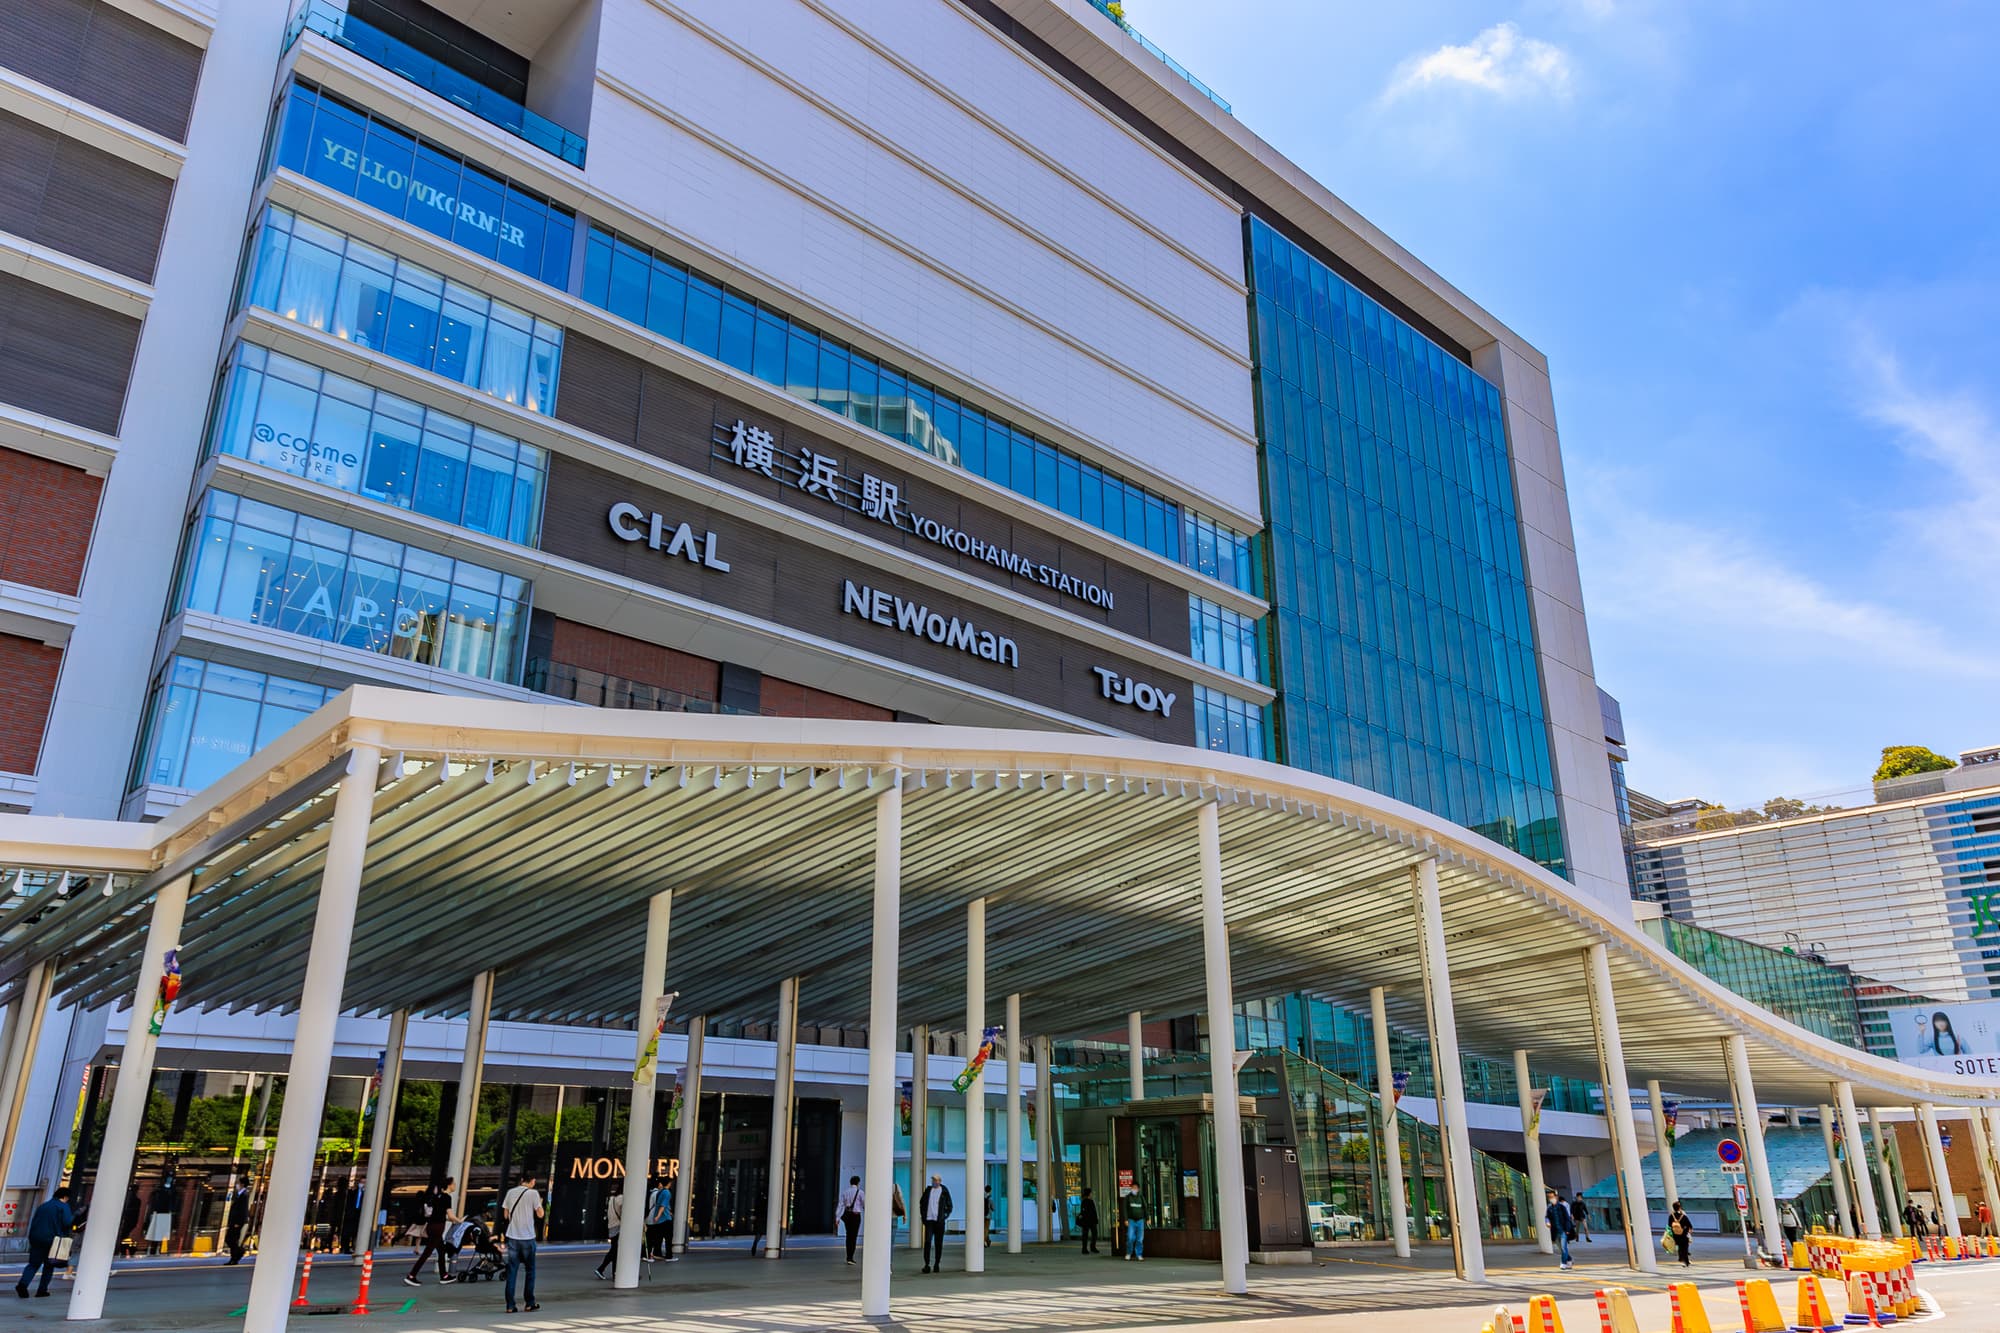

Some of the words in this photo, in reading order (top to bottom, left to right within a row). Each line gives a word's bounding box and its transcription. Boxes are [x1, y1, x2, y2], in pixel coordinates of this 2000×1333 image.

[322, 137, 526, 249] YELLOWKORNER
[254, 423, 358, 468] @cosme
[608, 502, 730, 573] CIAL
[730, 419, 899, 527] 横浜駅
[910, 512, 1034, 580] YOKOHAMA
[1038, 564, 1114, 611] STATION
[843, 579, 1019, 669] NEWoMan
[1954, 1057, 2000, 1075] SOTE
[570, 1157, 679, 1179] MONER
